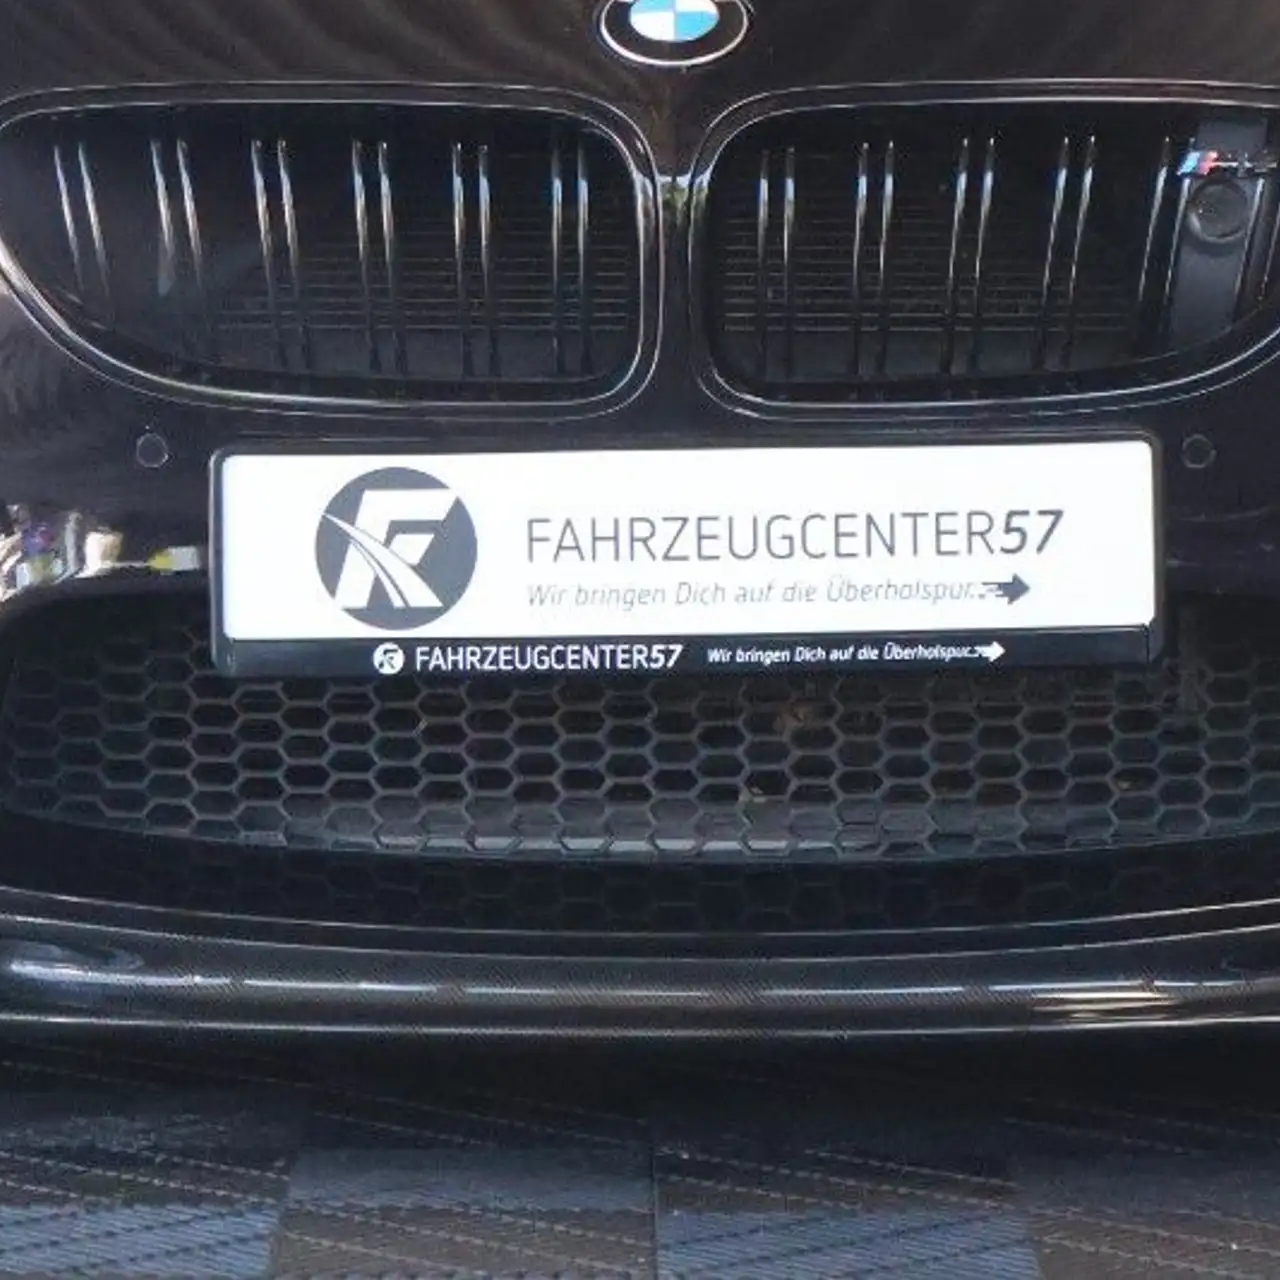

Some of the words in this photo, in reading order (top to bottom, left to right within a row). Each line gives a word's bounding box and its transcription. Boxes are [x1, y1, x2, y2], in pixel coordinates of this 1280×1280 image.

[526, 508, 1065, 564] FAHRZEUGCENTER57
[527, 582, 568, 607] Wir
[574, 583, 667, 612] bringen
[674, 581, 726, 605] Dich
[733, 579, 775, 604] auf
[781, 582, 818, 603] die
[415, 644, 684, 671] FAHRZEUGCENTER57
[707, 647, 732, 663] Wir
[735, 646, 791, 666] bringen
[793, 645, 826, 662] Dich
[829, 645, 855, 661] auf
[857, 644, 879, 660] die
